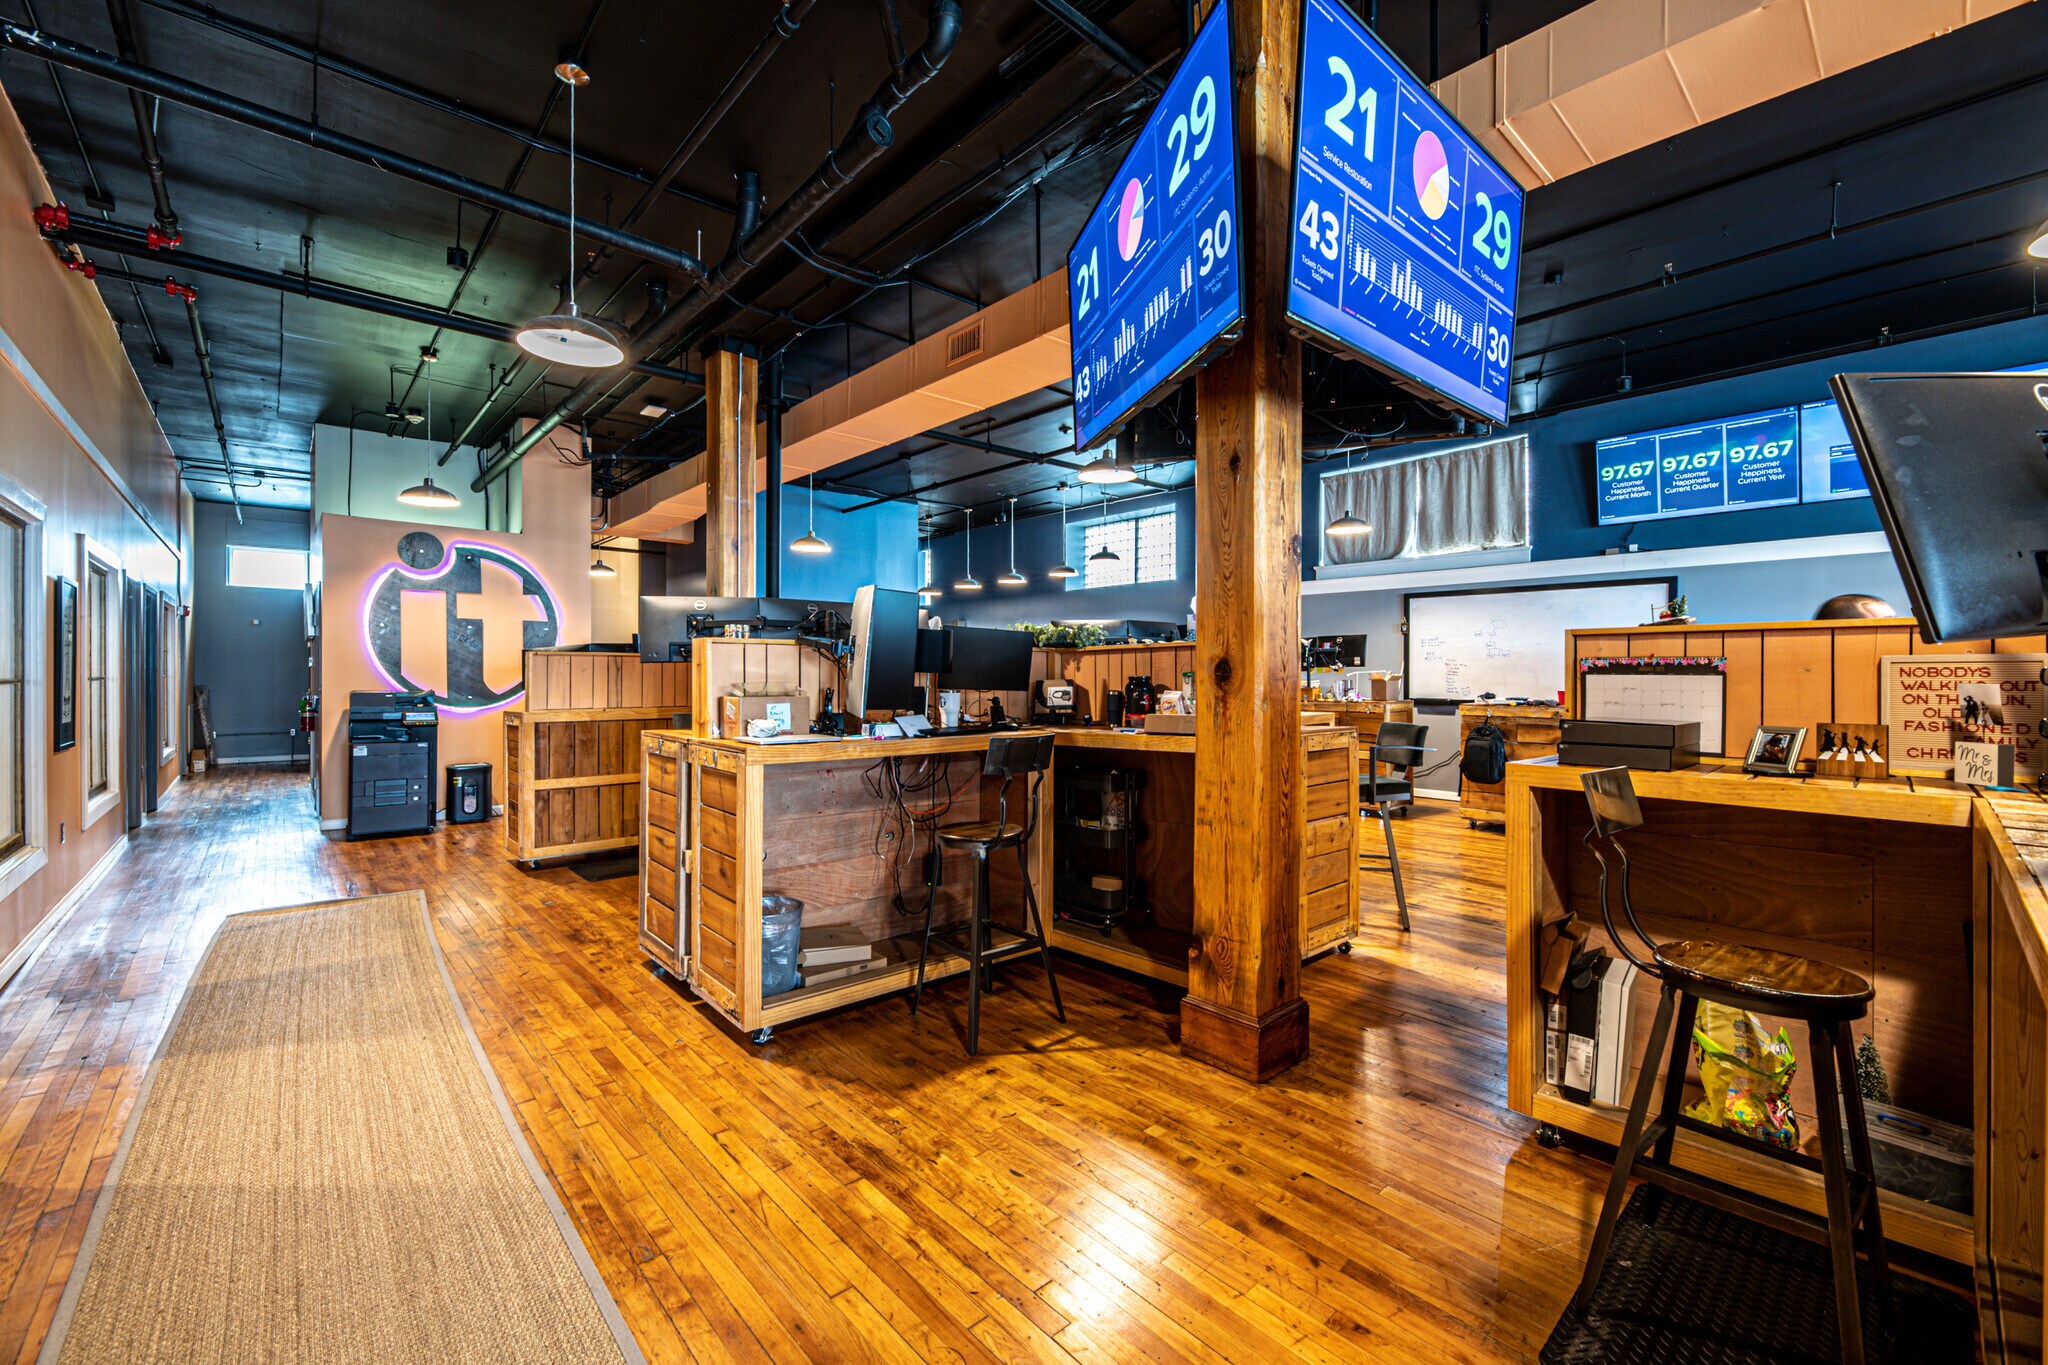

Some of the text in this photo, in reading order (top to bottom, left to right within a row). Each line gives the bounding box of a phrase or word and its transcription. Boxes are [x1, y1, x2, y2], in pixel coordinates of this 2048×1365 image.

[1325, 56, 1377, 162] 21
[1167, 76, 1216, 198] 29
[1199, 165, 1213, 186] Admin
[1323, 146, 1343, 169] Service
[1344, 162, 1372, 191] Restoration
[1300, 199, 1339, 260] 43
[1472, 192, 1511, 270] 29
[1198, 209, 1231, 276] 30
[1302, 254, 1334, 280] Tickets Opened
[1077, 246, 1098, 320] 21
[1311, 270, 1324, 284] Today
[1487, 326, 1509, 368] 30
[1075, 365, 1090, 403] 43
[1729, 439, 1793, 463] 97.67
[1662, 450, 1720, 472] 97.67
[1742, 460, 1780, 470] Customer
[1601, 460, 1655, 481] 97.67
[1674, 471, 1708, 480] Customer
[1737, 473, 1785, 485] Current Year
[1741, 468, 1782, 478] Happiness
[1612, 480, 1643, 488] Customer
[1664, 482, 1719, 494] Current Quarter
[1673, 476, 1710, 486] Happiness
[1605, 494, 1629, 502] Current
[1611, 486, 1645, 495] Happiness
[398, 532, 549, 698] it
[1901, 680, 2039, 691] WALKI OUT
[1902, 693, 1929, 705] ON
[1936, 693, 1959, 705] TH
[1923, 707, 1963, 719] OLD
[1904, 720, 2031, 735] FASHIONED
[1982, 754, 1992, 766] &
